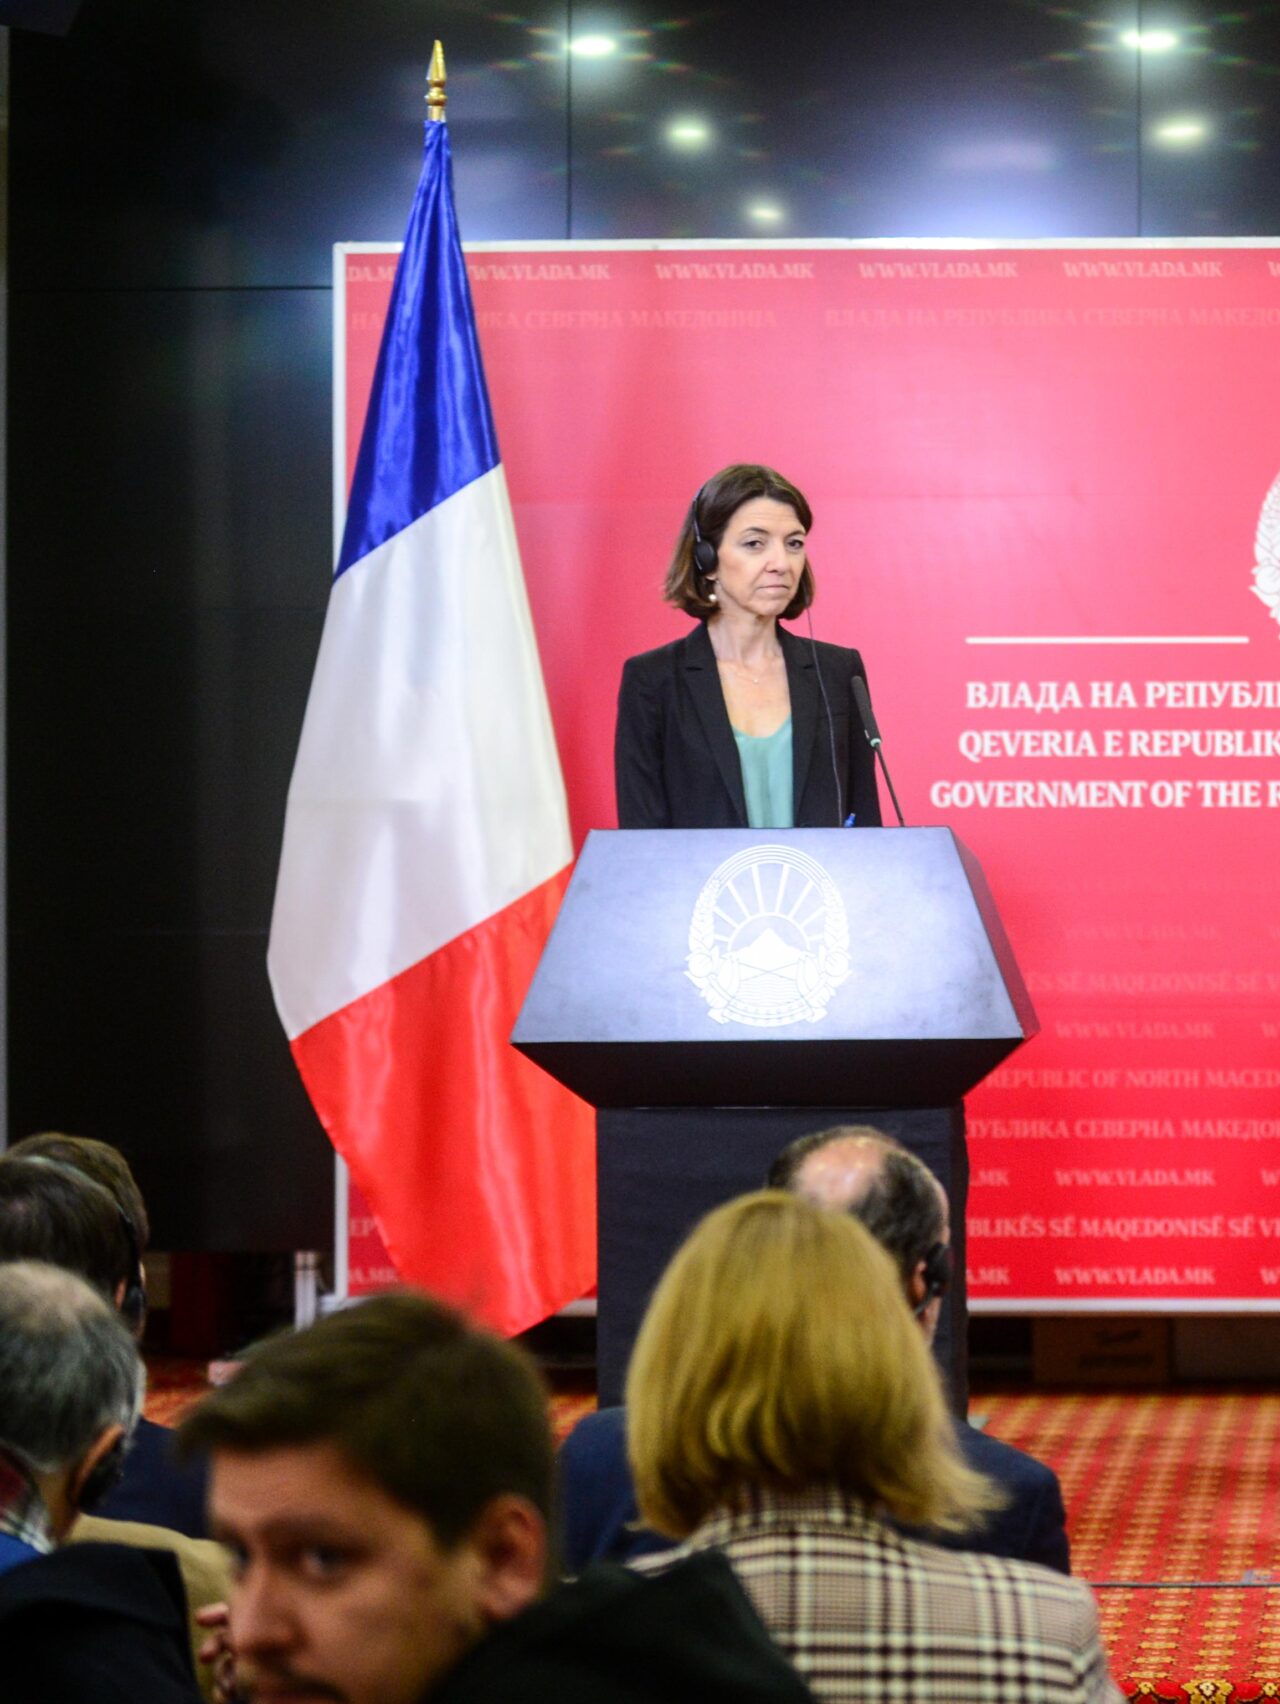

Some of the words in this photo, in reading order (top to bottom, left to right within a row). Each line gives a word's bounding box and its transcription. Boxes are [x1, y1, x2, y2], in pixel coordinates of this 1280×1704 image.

[655, 262, 815, 279] WWW.VLADA.MK
[858, 262, 1019, 278] WWW.VLADA.MK
[1063, 261, 1224, 277] WWW.VLADA.MK
[965, 680, 1084, 714] ВЛАДА
[1089, 680, 1139, 709] НА
[958, 730, 1098, 763] QEVERIA
[1103, 730, 1124, 757] E
[930, 780, 1148, 808] GOVERNMENT
[1150, 780, 1193, 808] OF
[1197, 780, 1261, 808] THE
[1092, 1069, 1120, 1088] OF
[1124, 1069, 1199, 1088] NORTH
[1075, 1119, 1174, 1139] СЕВЕРНА
[1055, 1169, 1215, 1186] WWW.VLADA.MK
[1080, 1214, 1223, 1241] MAQEDONISË
[1055, 1267, 1215, 1285] WWW.VLADA.MK
